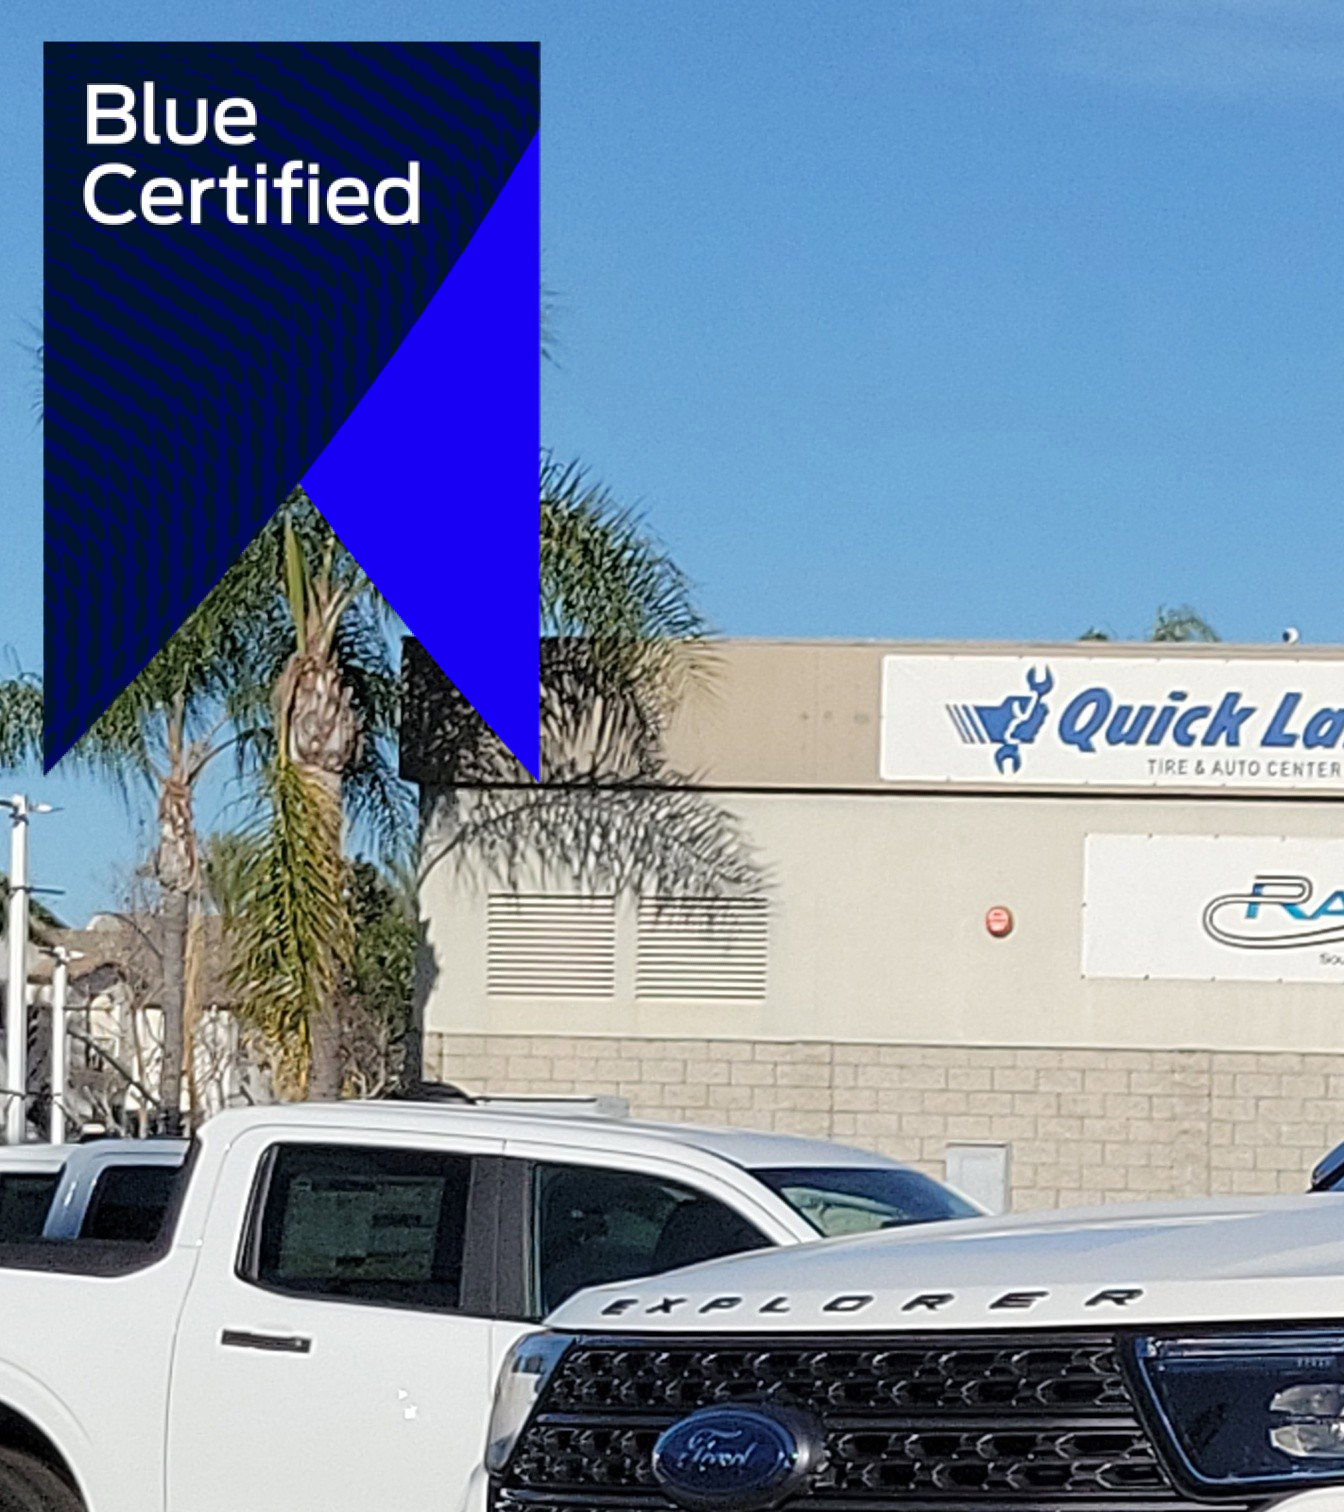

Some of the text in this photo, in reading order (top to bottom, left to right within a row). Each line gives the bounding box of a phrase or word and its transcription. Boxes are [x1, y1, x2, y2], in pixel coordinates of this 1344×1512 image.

[1057, 686, 1257, 752] Quick
[1147, 758, 1341, 778] TIRE & AUTO CENTER
[600, 1288, 1144, 1317] EXPLORER
[676, 1428, 759, 1473] Ford
